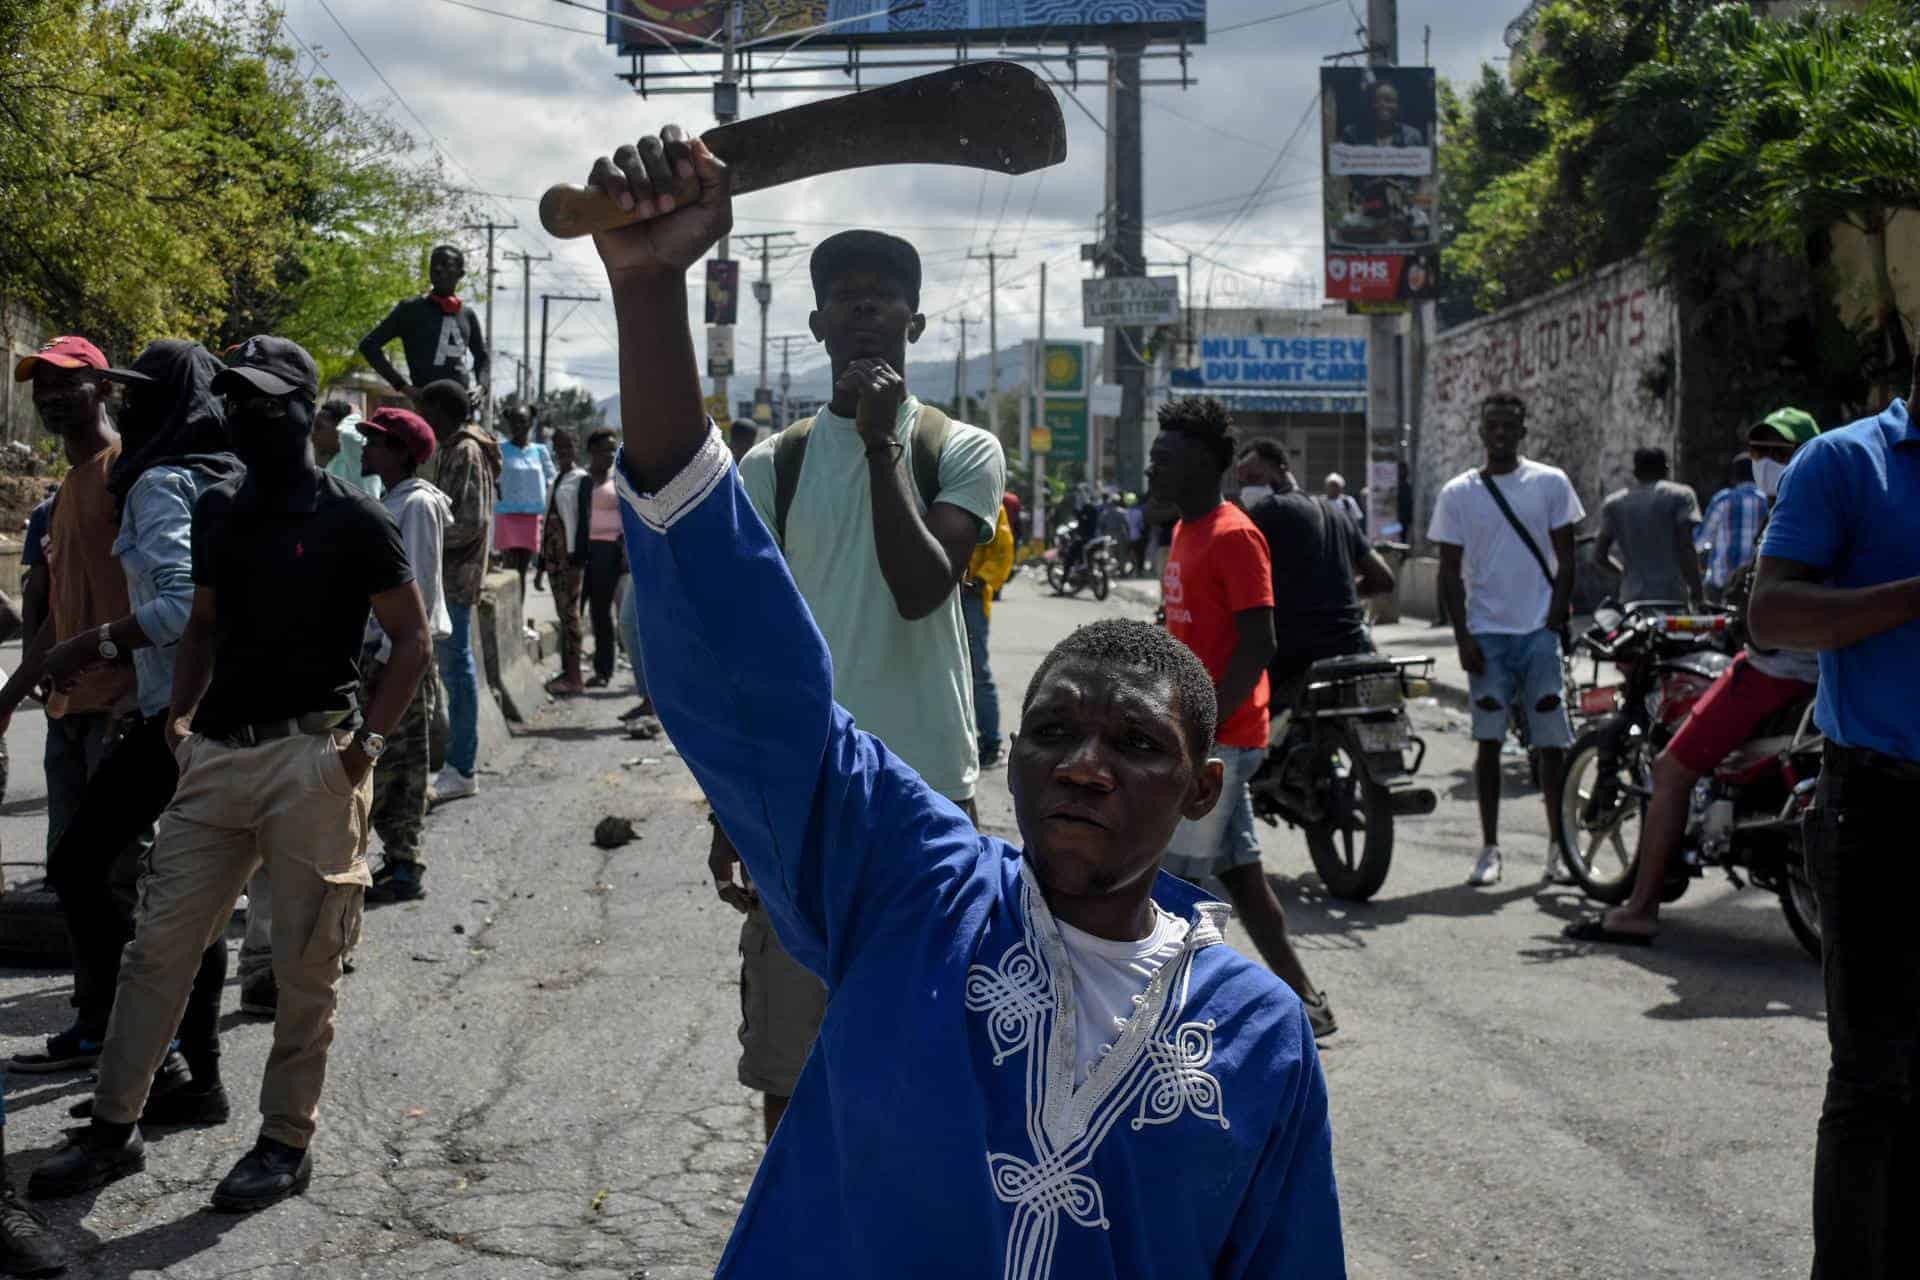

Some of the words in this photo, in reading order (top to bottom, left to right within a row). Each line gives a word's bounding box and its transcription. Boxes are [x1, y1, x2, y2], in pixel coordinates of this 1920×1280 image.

[1349, 260, 1388, 280] PHS
[433, 315, 467, 370] A
[1565, 287, 1647, 362] PARTS
[1207, 361, 1239, 381] DU
